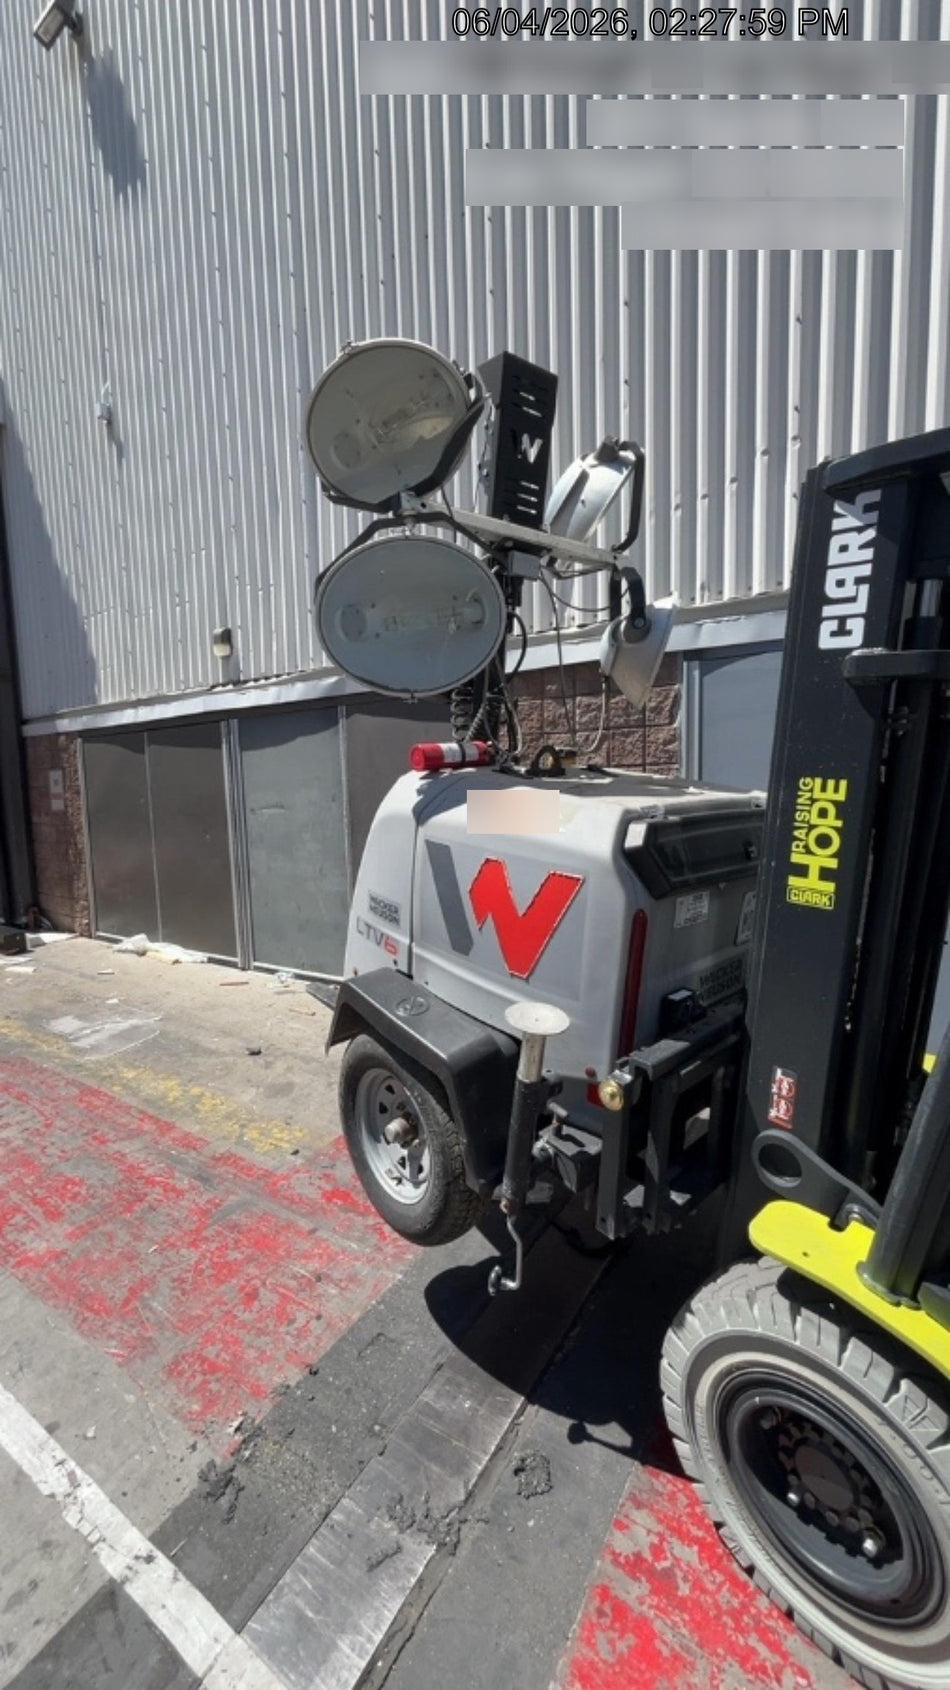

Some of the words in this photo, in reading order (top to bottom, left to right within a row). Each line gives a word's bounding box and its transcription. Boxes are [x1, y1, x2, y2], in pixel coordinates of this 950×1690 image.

[818, 489, 882, 649] CLARK
[787, 776, 848, 893] HOPE
[791, 776, 814, 853] RAISING
[356, 914, 398, 956] LTV6
[789, 888, 832, 907] CLARK
